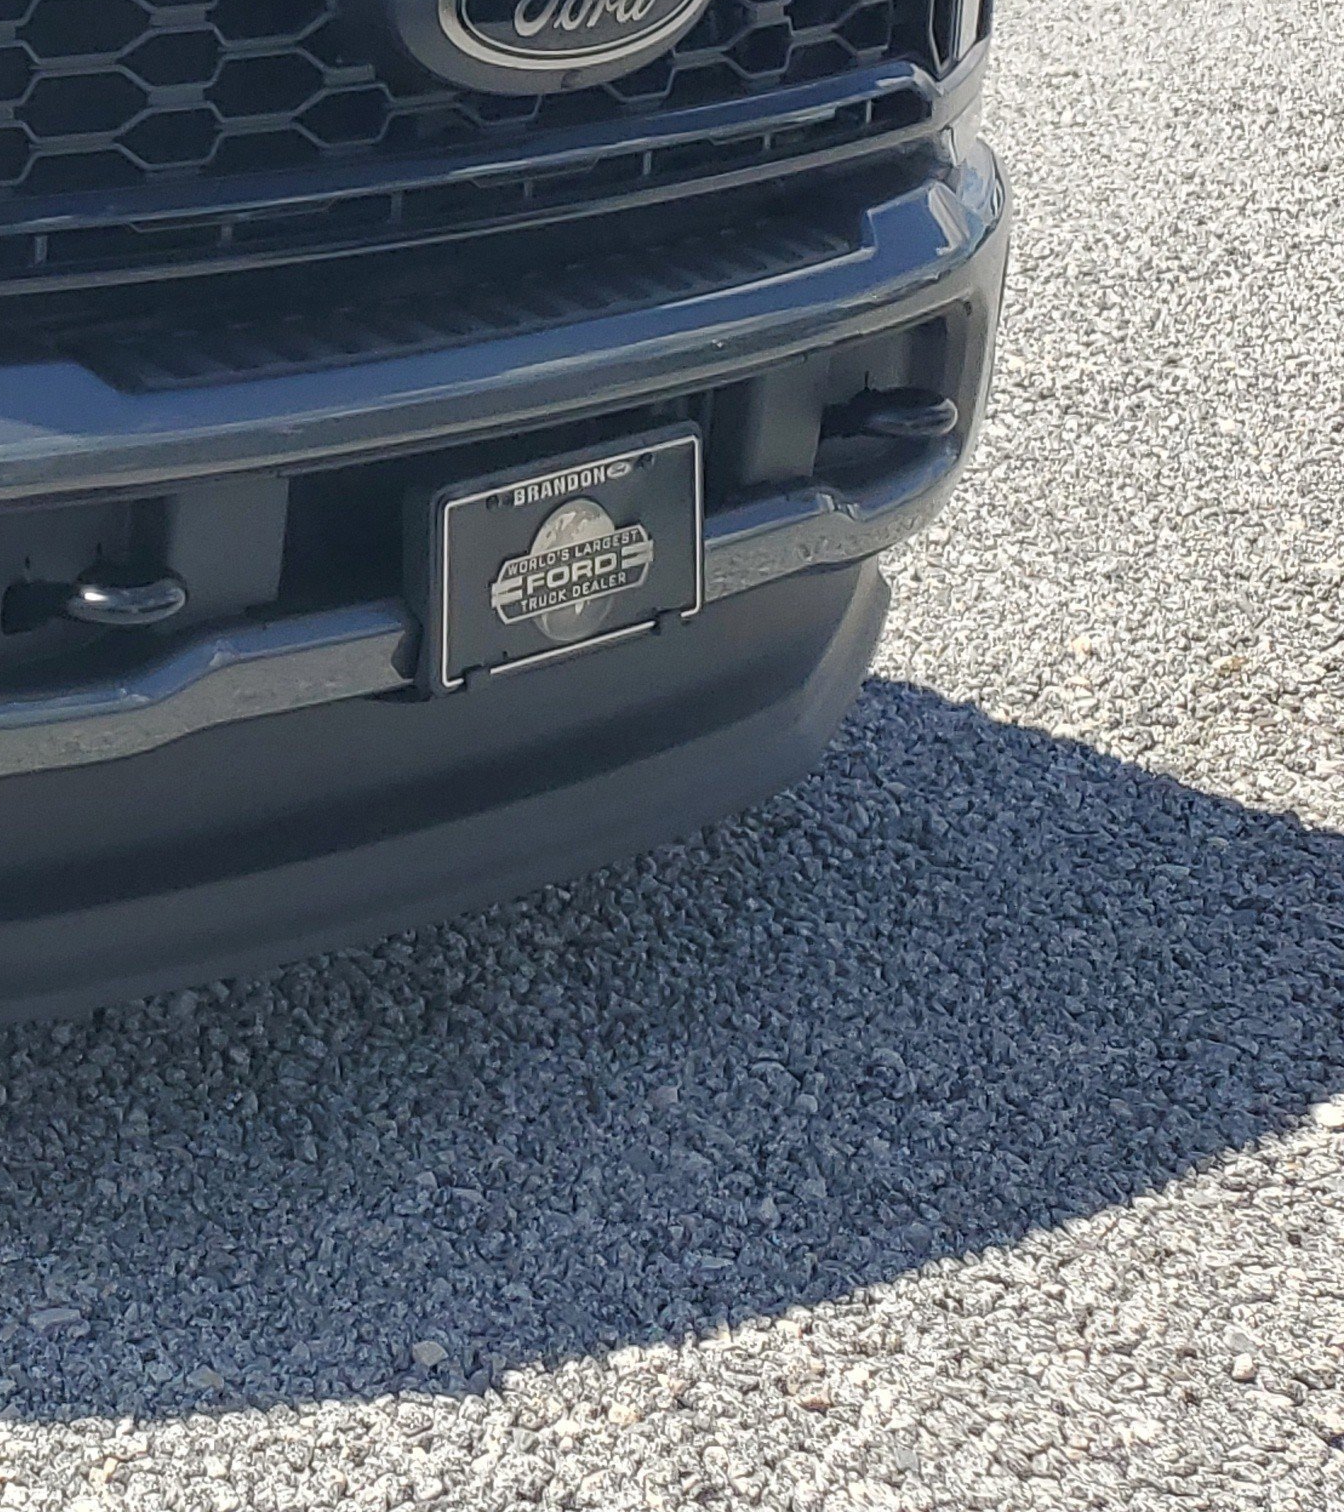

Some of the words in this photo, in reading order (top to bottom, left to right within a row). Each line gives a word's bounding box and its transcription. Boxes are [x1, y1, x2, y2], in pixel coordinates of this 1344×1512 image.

[513, 465, 606, 506] BRANDON
[507, 550, 569, 576] WORLD'S
[575, 529, 639, 557] LARGEST
[526, 552, 617, 595] FORD
[520, 588, 567, 612] TRUCK
[572, 572, 627, 597] DEALER
